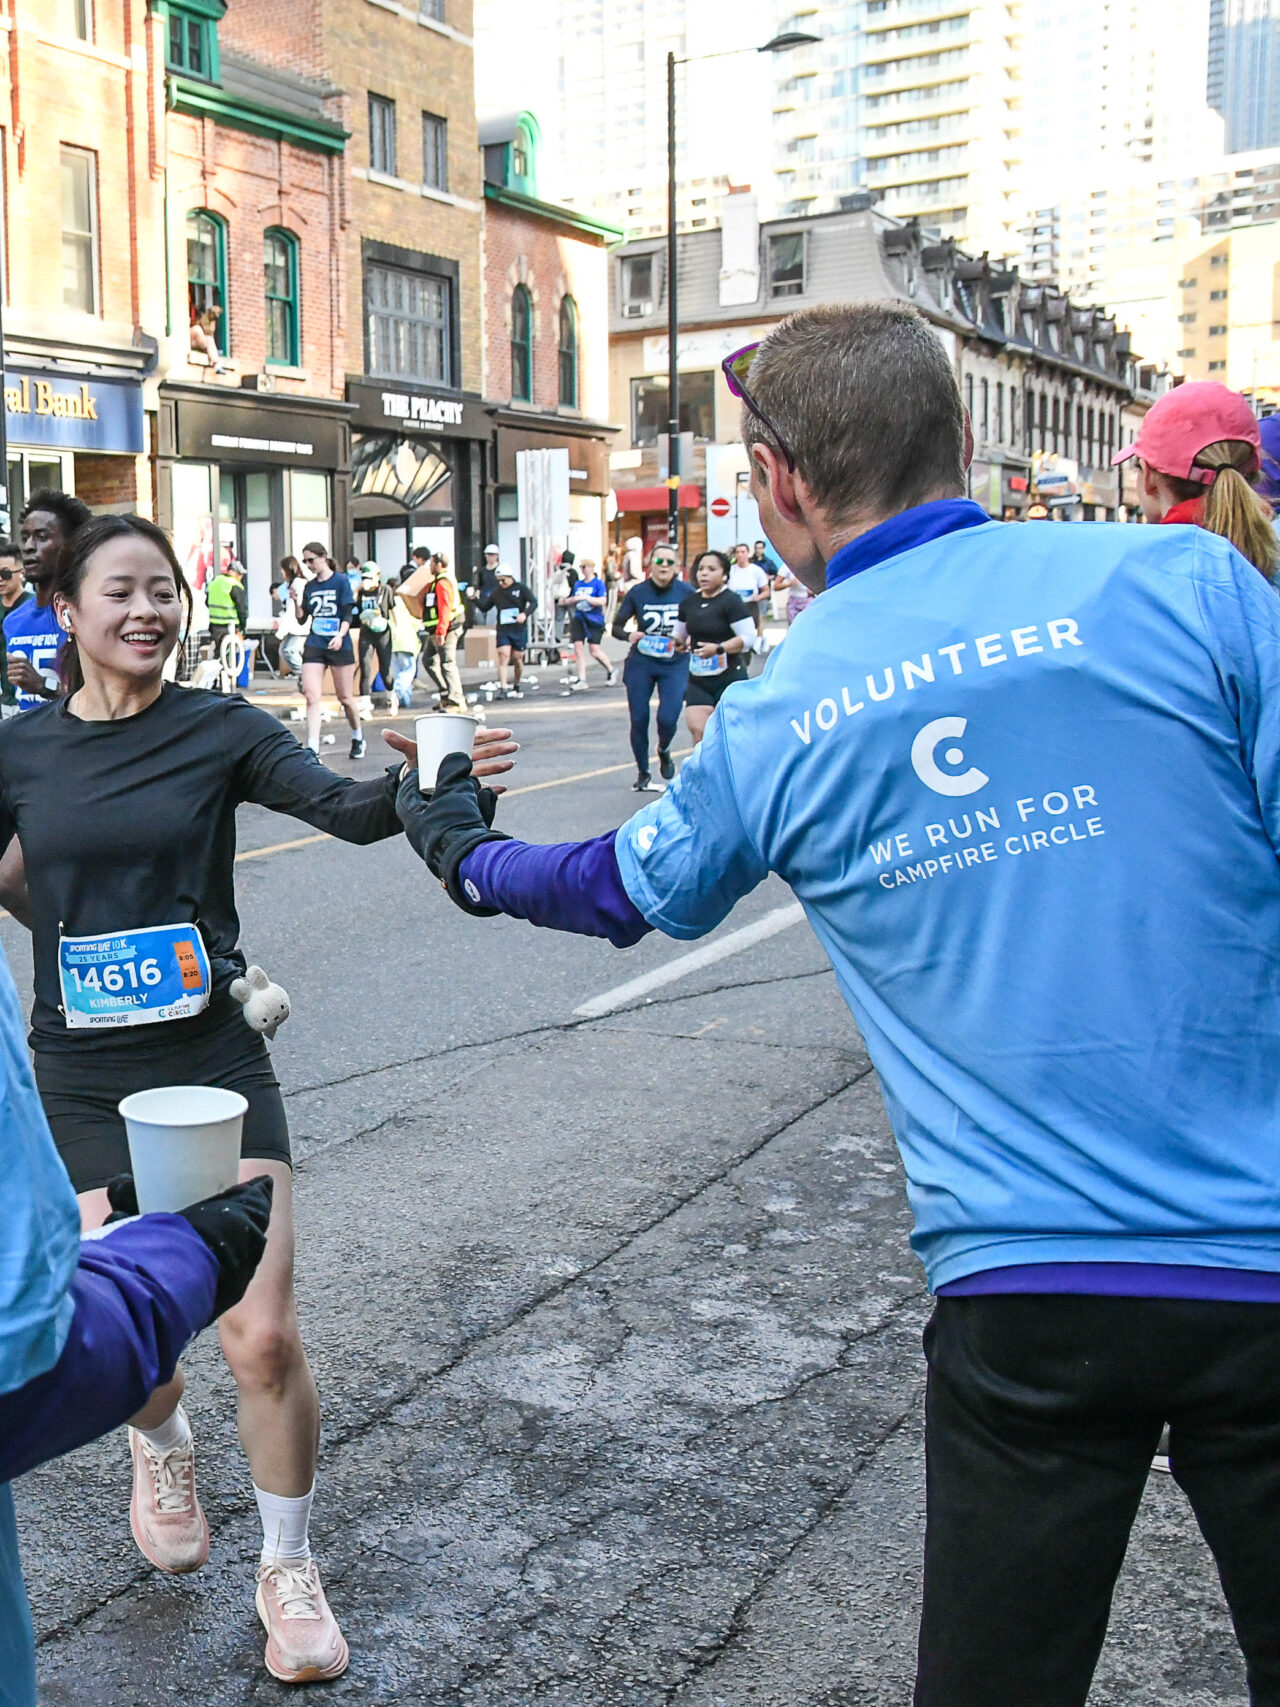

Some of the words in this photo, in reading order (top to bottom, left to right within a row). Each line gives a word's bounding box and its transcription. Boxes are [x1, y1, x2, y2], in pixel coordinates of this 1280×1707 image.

[35, 380, 98, 420] Bank
[381, 392, 410, 418] THE
[410, 396, 464, 425] PEACHY
[309, 596, 338, 617] 25
[642, 611, 679, 636] 25
[790, 617, 1084, 745] VOLUNTEER
[869, 833, 914, 865] WE
[925, 806, 1001, 848] RUN
[1016, 784, 1099, 822] FOR
[878, 842, 998, 889] CAMPFIRE
[1005, 816, 1106, 856] CIRCLE
[91, 952, 119, 962] YEARS
[112, 938, 128, 950] 10K
[69, 958, 162, 993] 14616
[89, 992, 148, 1009] KIMBERLY
